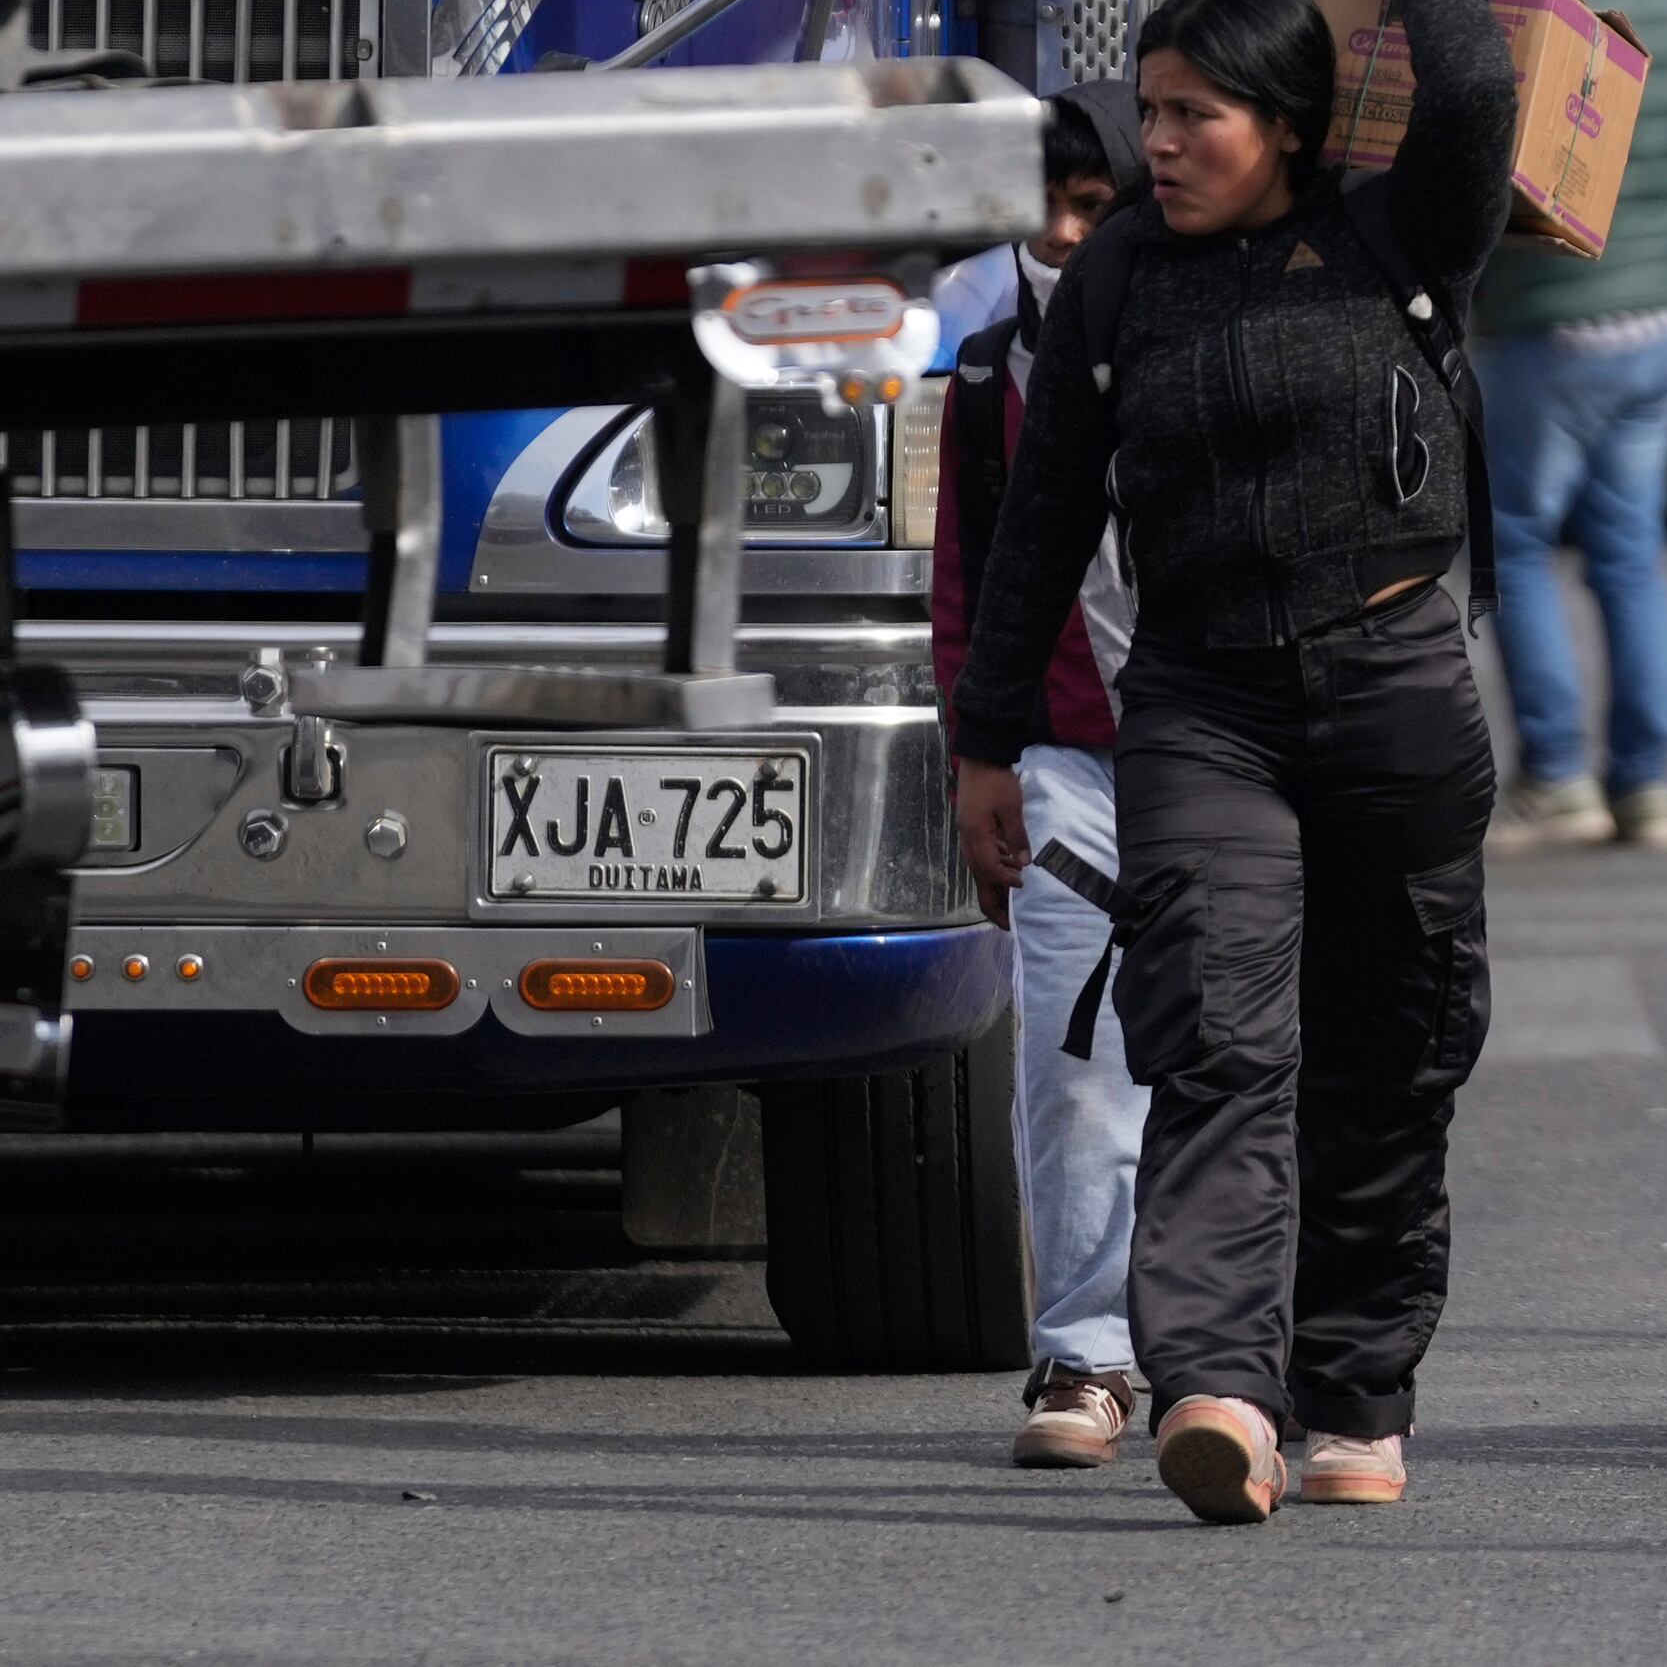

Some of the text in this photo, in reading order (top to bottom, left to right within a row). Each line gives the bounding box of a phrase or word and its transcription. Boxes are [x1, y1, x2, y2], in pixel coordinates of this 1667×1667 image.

[753, 503, 792, 515] LED
[500, 774, 795, 859] XJA 725
[589, 863, 705, 891] DUITAMA
